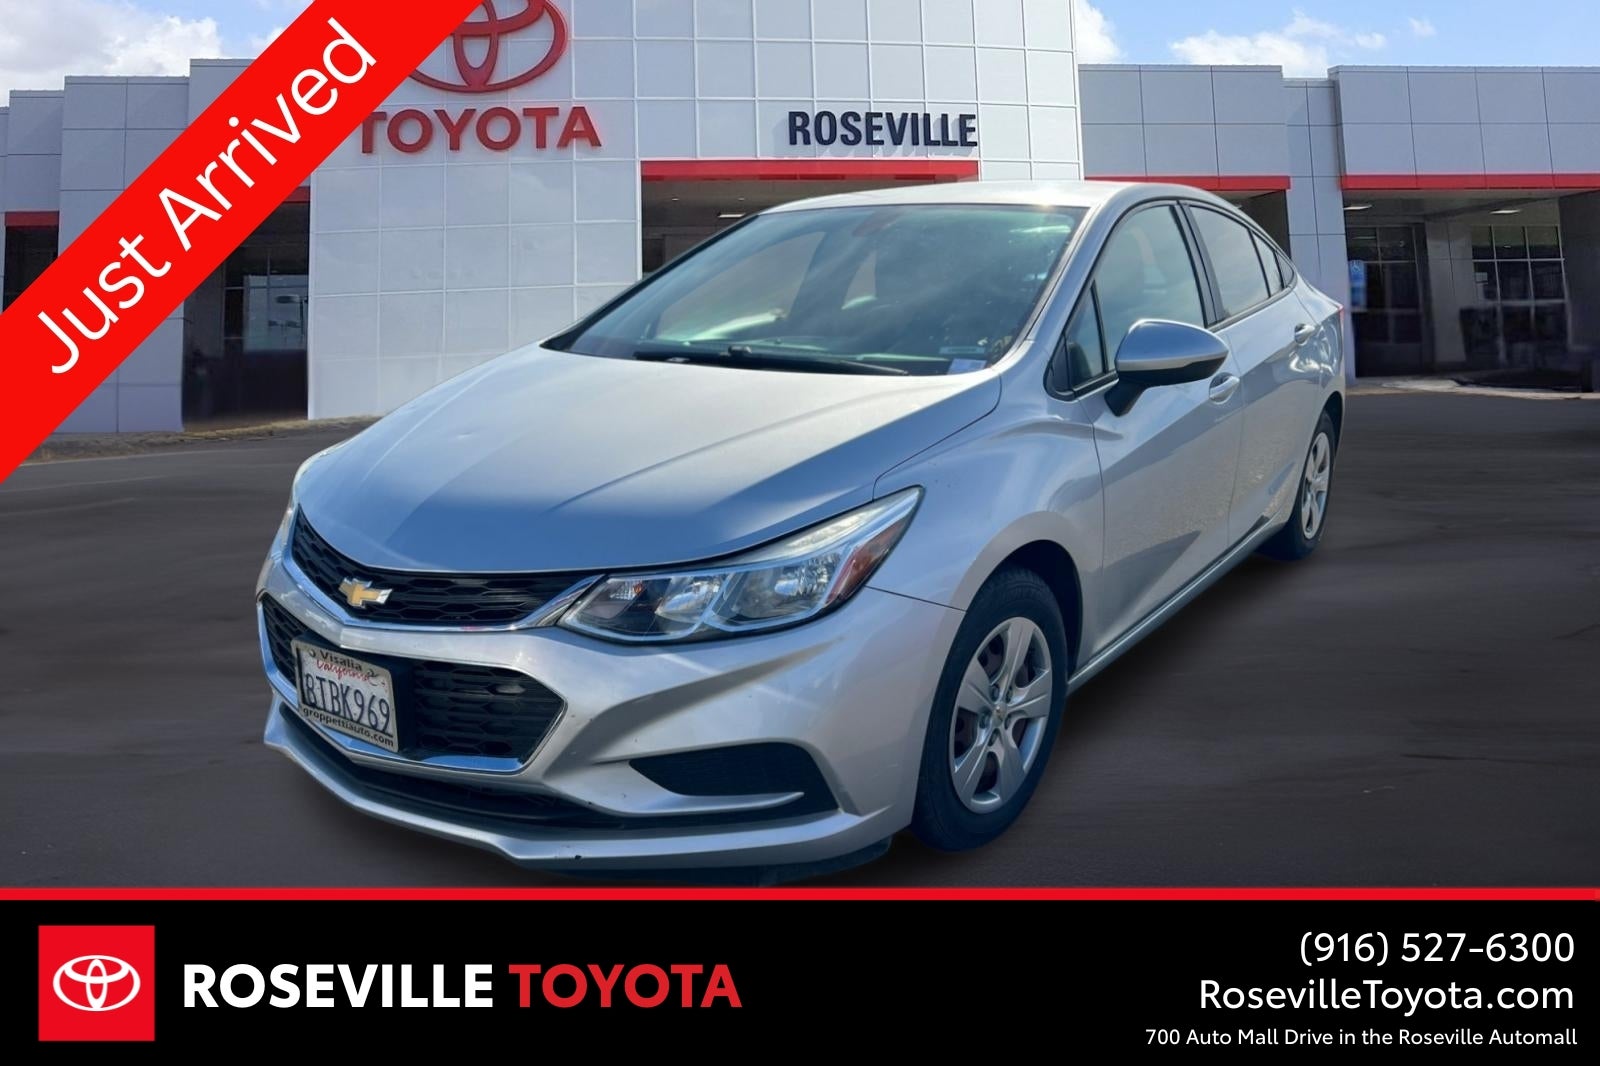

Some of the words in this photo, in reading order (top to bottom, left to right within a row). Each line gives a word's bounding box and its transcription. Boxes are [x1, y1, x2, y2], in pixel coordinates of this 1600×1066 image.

[361, 106, 602, 154] TOYOTA
[788, 111, 978, 147] ROSEVILLE
[319, 650, 362, 671] Visalia
[306, 673, 390, 733] 8TBK969
[303, 708, 394, 747] groppettiauto.com
